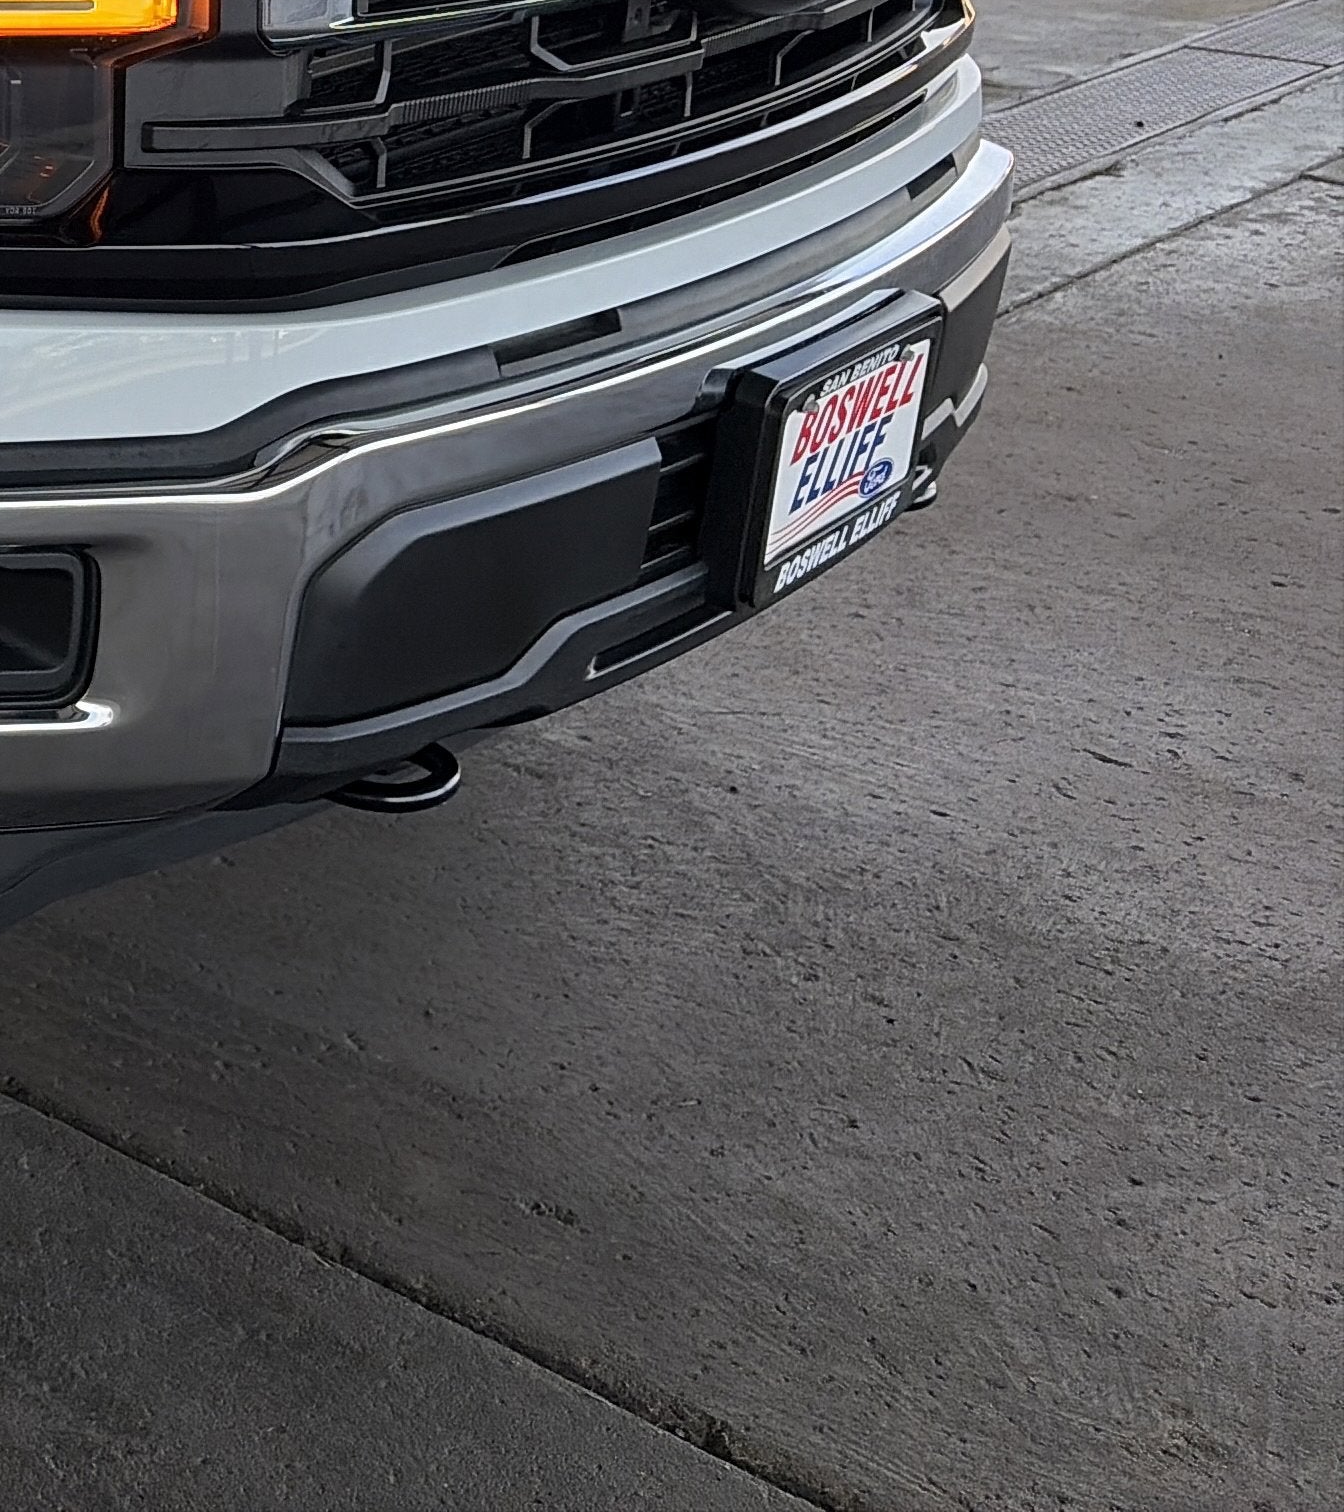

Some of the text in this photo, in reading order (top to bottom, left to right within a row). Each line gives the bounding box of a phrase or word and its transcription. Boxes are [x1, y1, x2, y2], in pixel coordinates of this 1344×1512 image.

[790, 352, 925, 467] BOSWELL
[819, 343, 901, 399] SAN BENITO
[789, 413, 896, 516] ELLIFF
[773, 491, 902, 594] BOSWELL ELLIFF
